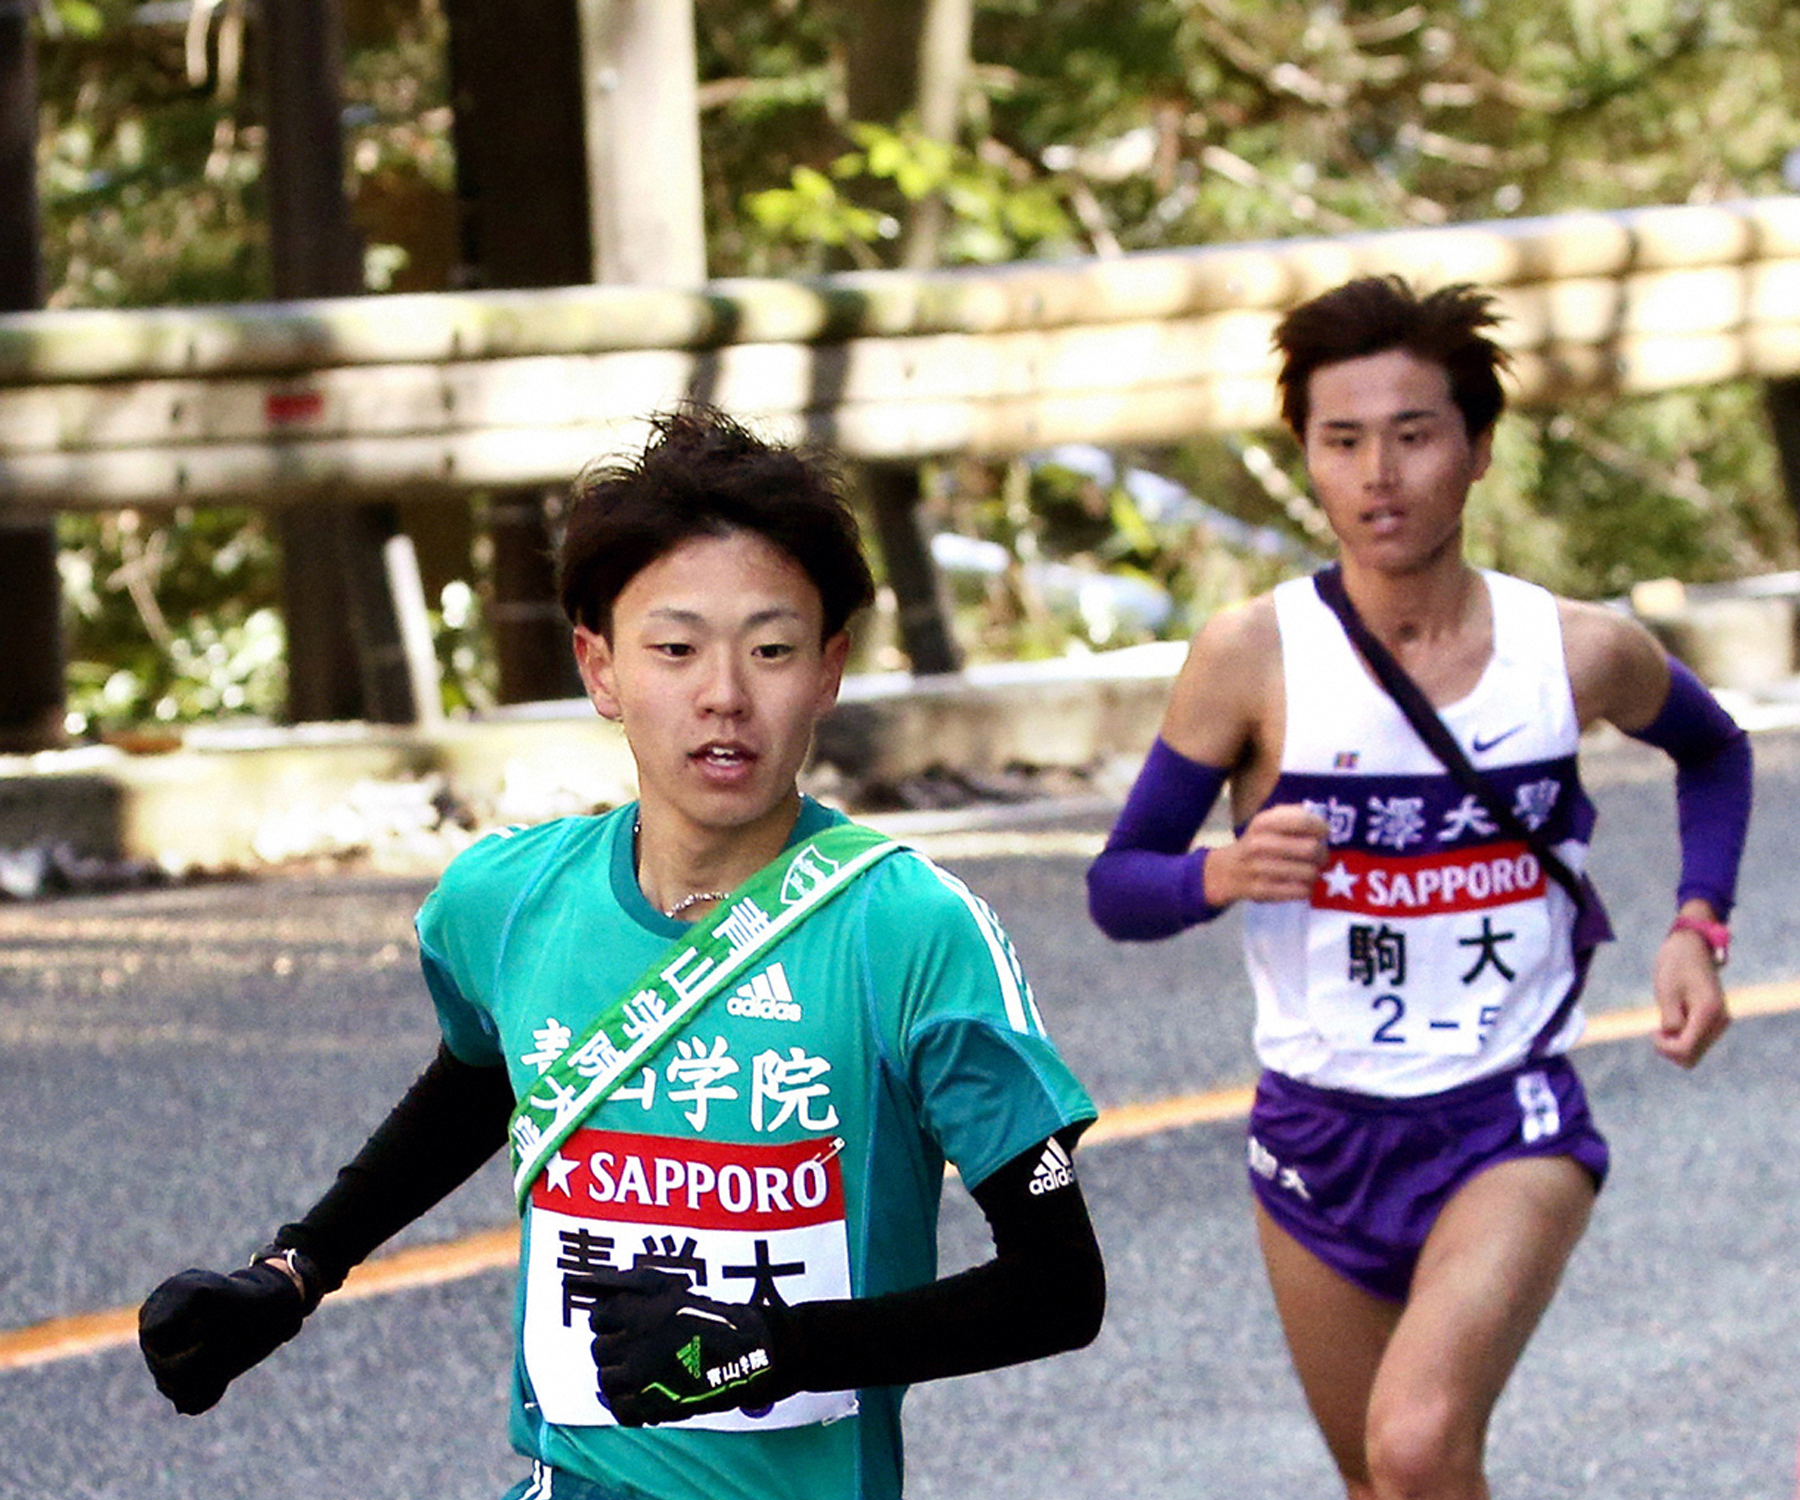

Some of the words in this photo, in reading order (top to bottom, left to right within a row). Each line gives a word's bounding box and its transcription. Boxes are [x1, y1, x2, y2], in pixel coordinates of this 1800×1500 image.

[1366, 853, 1540, 907] SAPPORO
[1348, 916, 1515, 986] 駒大
[727, 997, 801, 1022] adidas
[588, 1151, 828, 1213] SAPPORO
